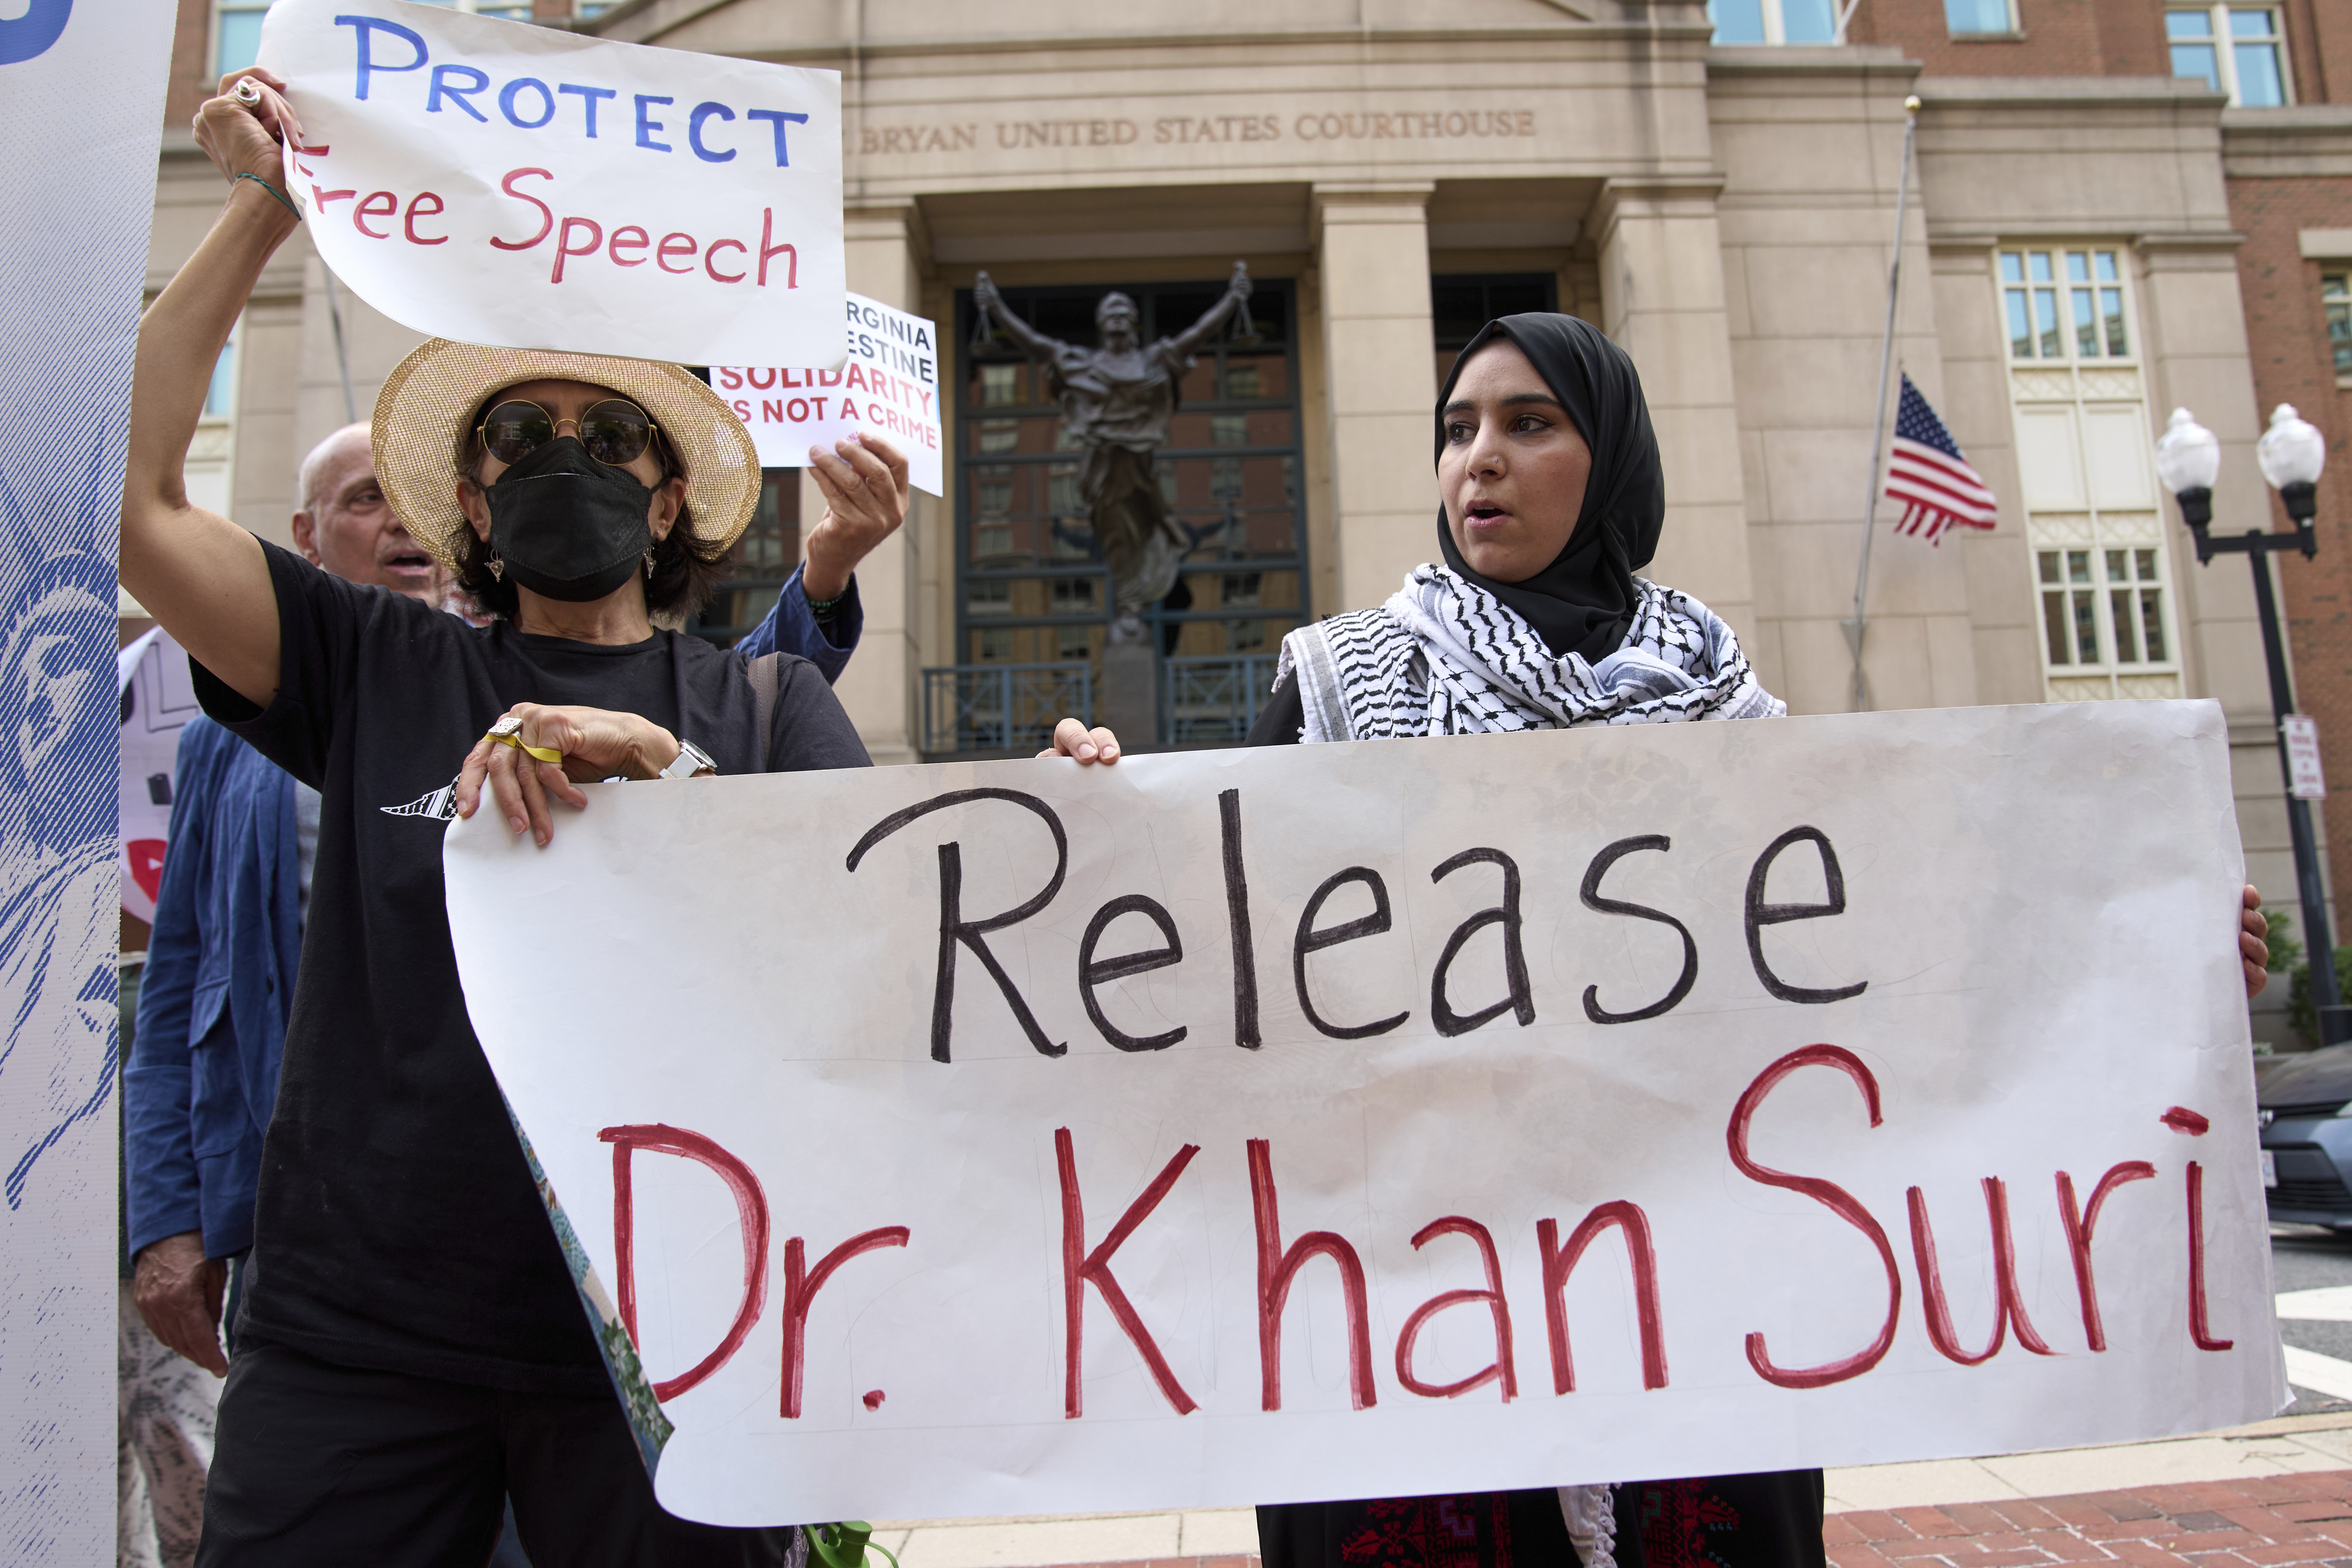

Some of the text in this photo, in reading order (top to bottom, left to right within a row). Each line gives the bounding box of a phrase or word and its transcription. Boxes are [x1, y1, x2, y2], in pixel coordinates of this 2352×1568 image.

[335, 15, 808, 167] PROTECT
[861, 125, 977, 155] BRYAN
[995, 118, 1140, 150] UNITED
[1154, 114, 1282, 144] STATES
[1293, 110, 1537, 141] COURTHOUSE
[490, 168, 798, 289] Speech
[720, 363, 931, 416] SOLIDARITY
[724, 399, 752, 423] S
[762, 397, 828, 423] NOT
[840, 397, 860, 420] A
[868, 403, 936, 449] CRIME
[846, 788, 1869, 1064] Release
[597, 1043, 2234, 1419] Dr. Khan Suri
